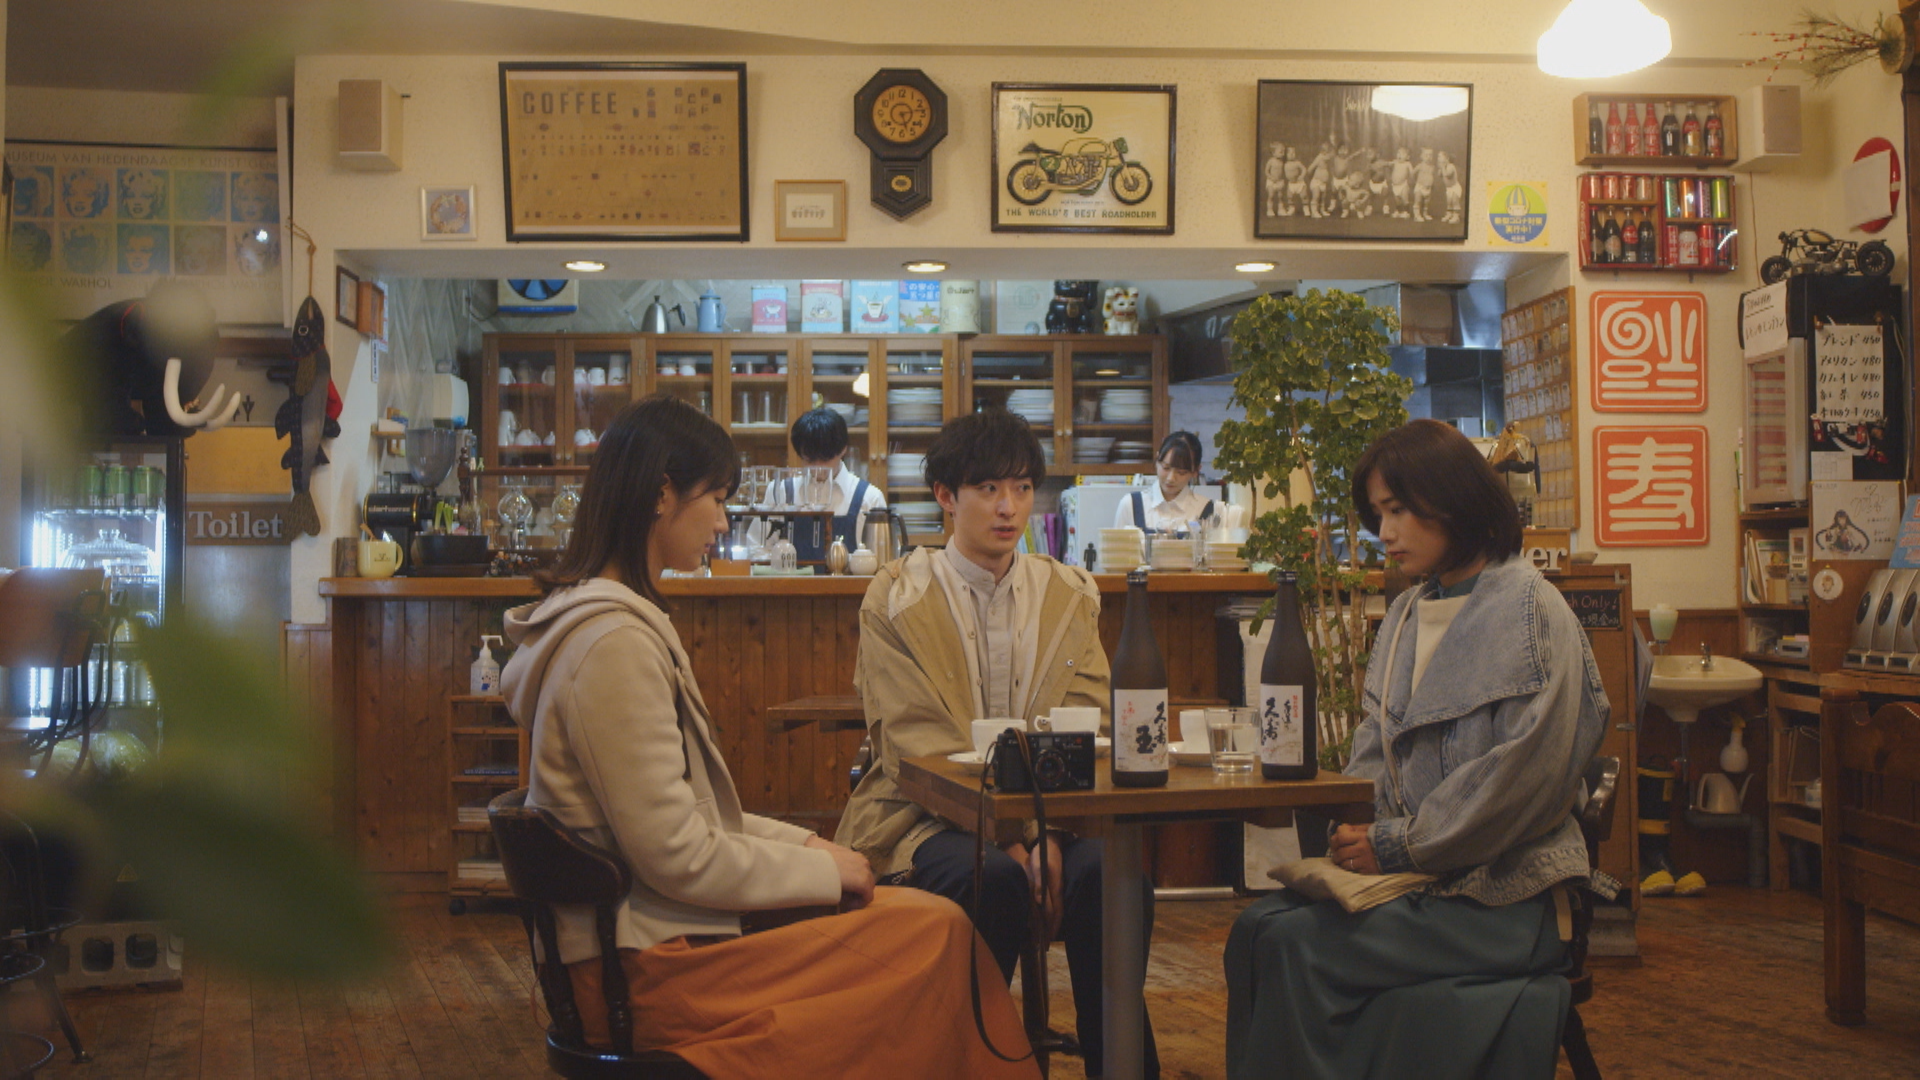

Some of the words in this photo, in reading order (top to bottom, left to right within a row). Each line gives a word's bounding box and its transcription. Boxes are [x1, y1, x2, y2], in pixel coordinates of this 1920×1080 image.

[522, 91, 617, 115] COFFEE
[1012, 102, 1093, 134] Norton
[1006, 207, 1022, 217] THE
[1074, 209, 1096, 219] BEST
[188, 511, 283, 538] Toilet
[1525, 547, 1568, 571] er
